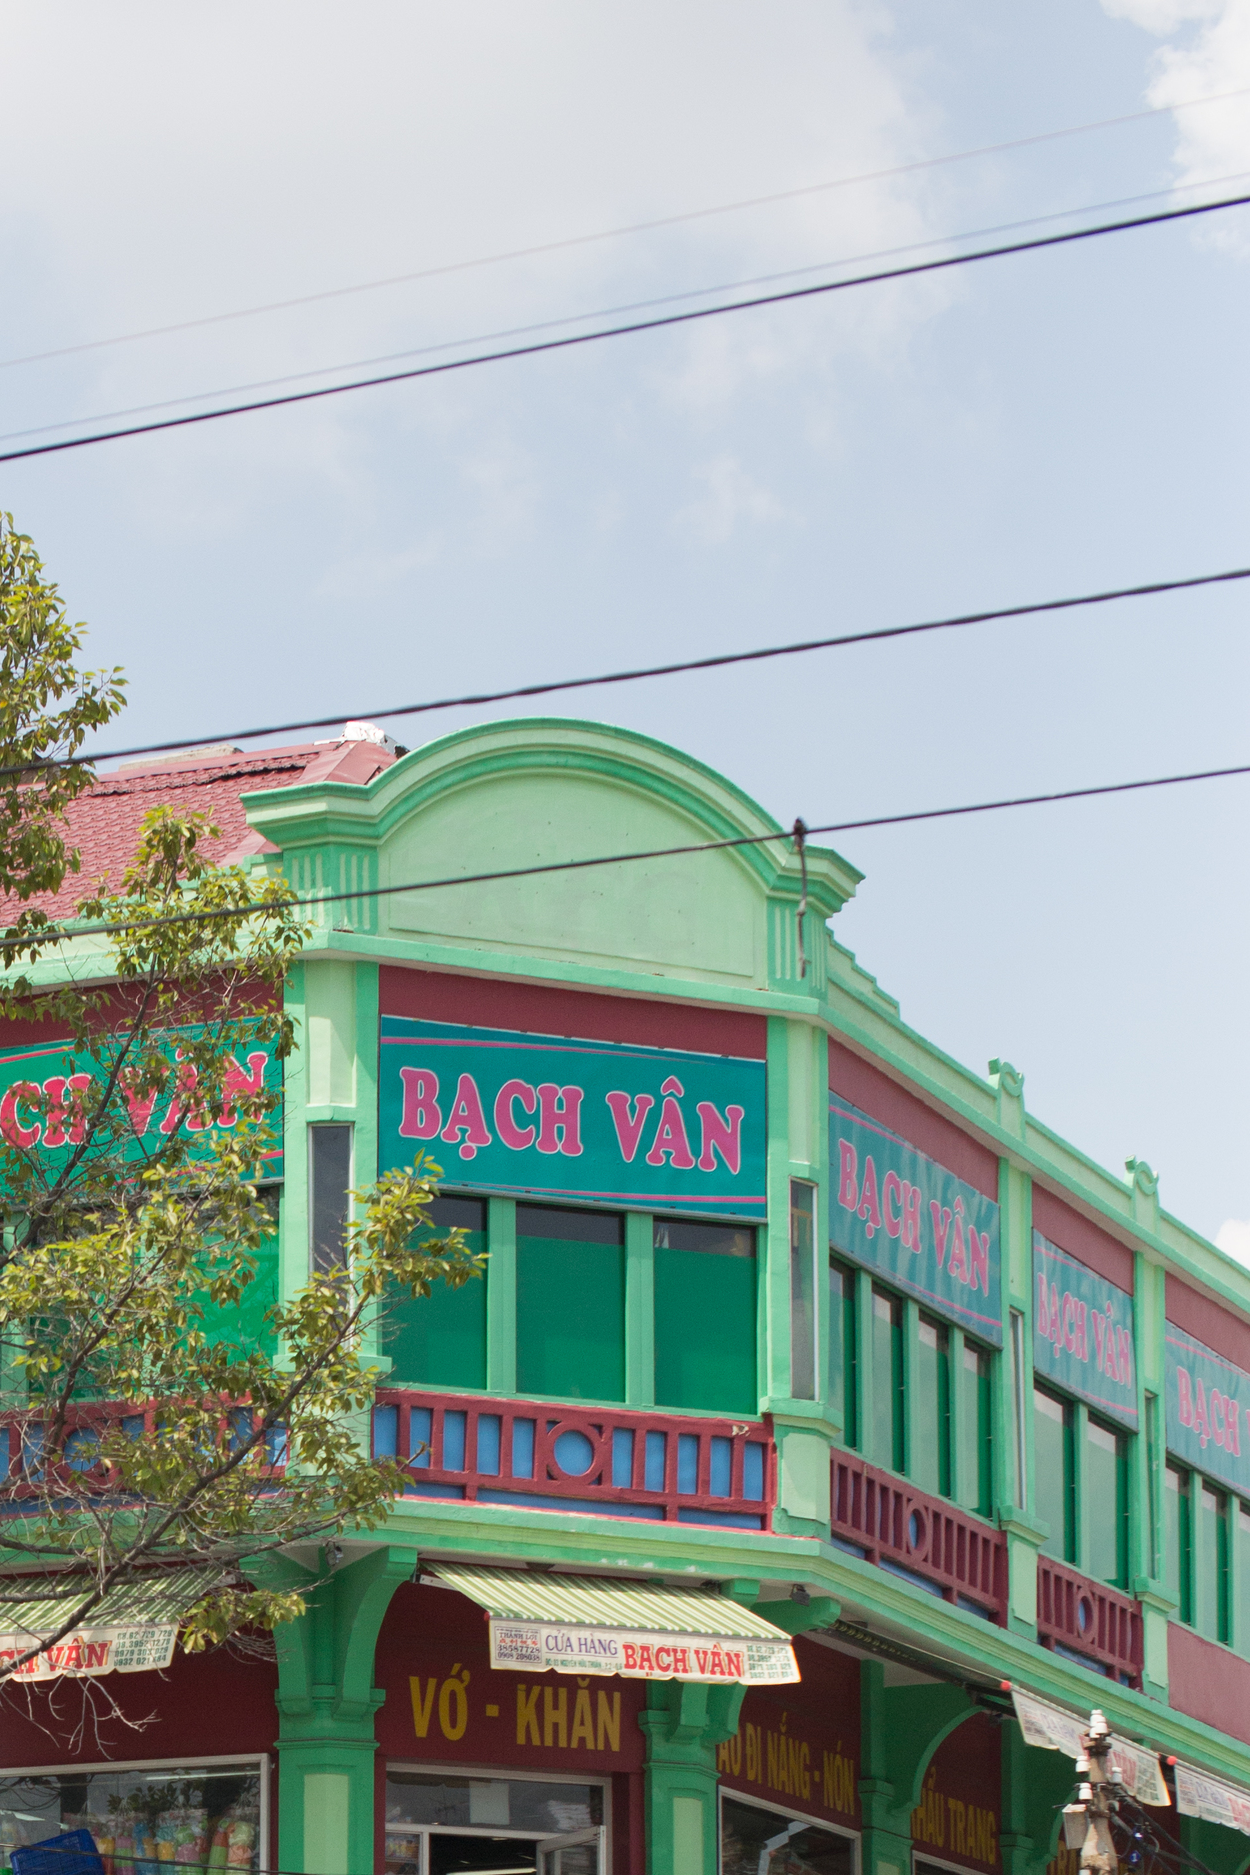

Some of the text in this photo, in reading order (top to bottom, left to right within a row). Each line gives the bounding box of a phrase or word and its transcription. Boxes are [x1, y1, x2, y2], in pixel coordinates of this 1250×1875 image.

[397, 1065, 746, 1176] BẠCH VÂN
[837, 1137, 990, 1297] BẠCH VÂN
[1037, 1271, 1132, 1389] BẠCH VÂN
[1176, 1365, 1241, 1457] BẠCH
[46, 1635, 114, 1672] VÂN
[545, 1629, 618, 1656] CỬA HÀNG
[622, 1642, 692, 1677] BẠCH
[694, 1642, 745, 1677] VÂN
[408, 1661, 472, 1742] VỚ
[515, 1673, 623, 1753] KHĂN
[823, 1739, 855, 1816] NÓN
[947, 1796, 997, 1866] TRANG
